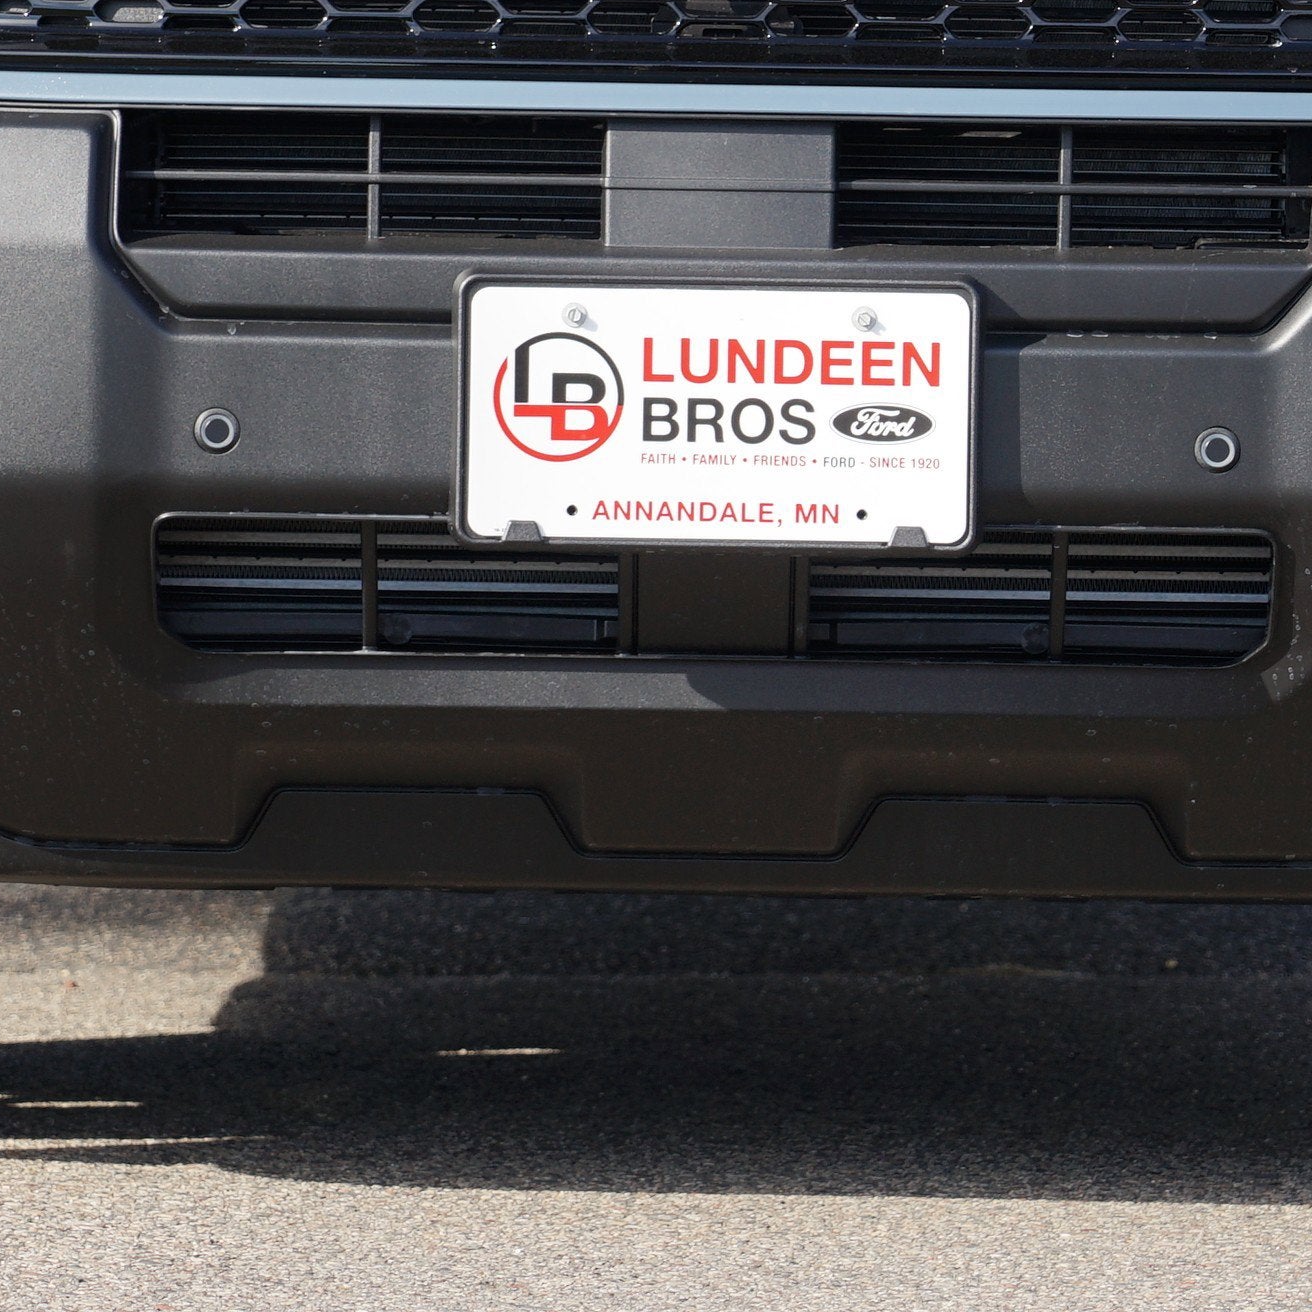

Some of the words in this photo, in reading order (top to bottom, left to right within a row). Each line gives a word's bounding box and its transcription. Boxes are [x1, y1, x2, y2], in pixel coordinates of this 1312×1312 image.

[642, 337, 941, 388] LUNDEEN
[642, 396, 816, 446] BROS
[849, 407, 916, 440] Ford
[640, 453, 677, 464] FAITH
[692, 454, 737, 465] FAMILY
[753, 455, 807, 467] FRIENDS
[823, 456, 856, 468] FORD
[869, 456, 906, 468] SINCE
[911, 458, 941, 469] 1920
[591, 499, 784, 528] ANNANDALE,
[795, 503, 839, 524] MN
